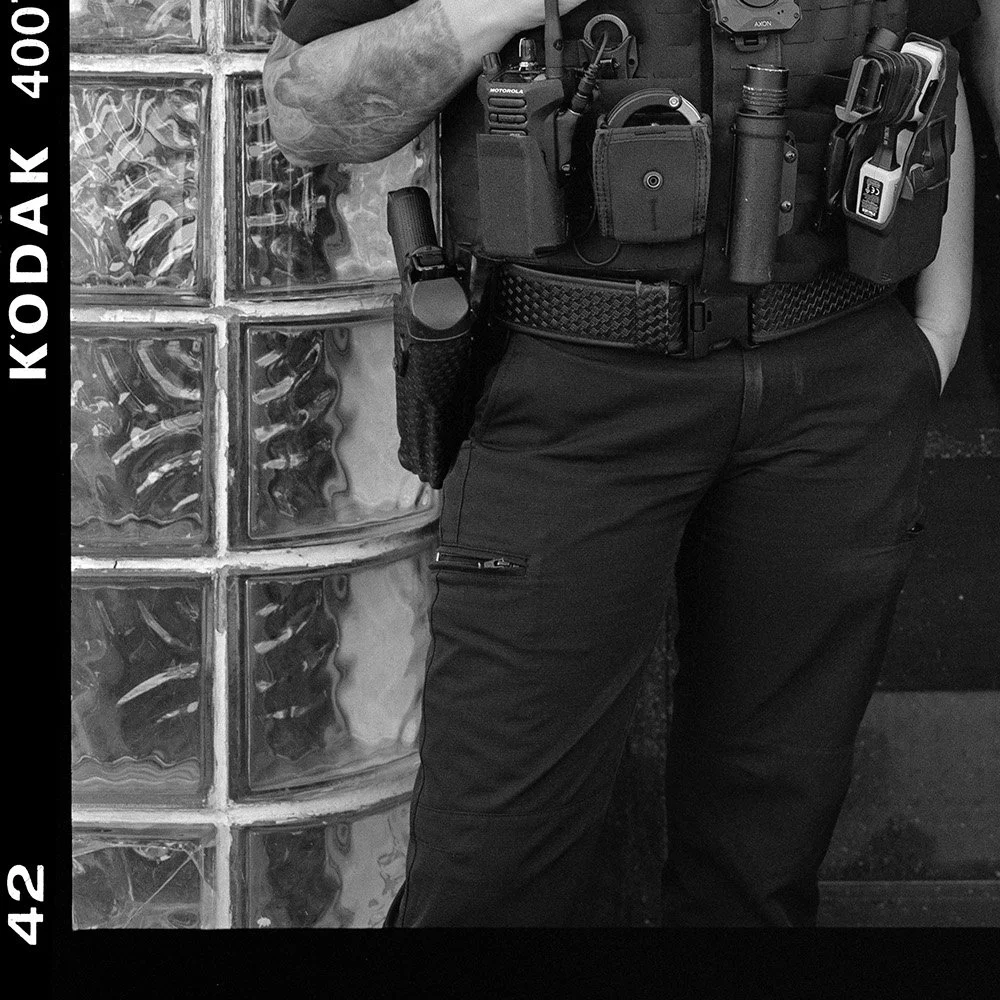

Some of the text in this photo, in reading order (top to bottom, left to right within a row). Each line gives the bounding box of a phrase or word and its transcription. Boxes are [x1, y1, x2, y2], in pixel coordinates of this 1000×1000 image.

[754, 20, 772, 28] AXON
[9, 147, 48, 379] KODAK
[7, 865, 45, 945] 42
